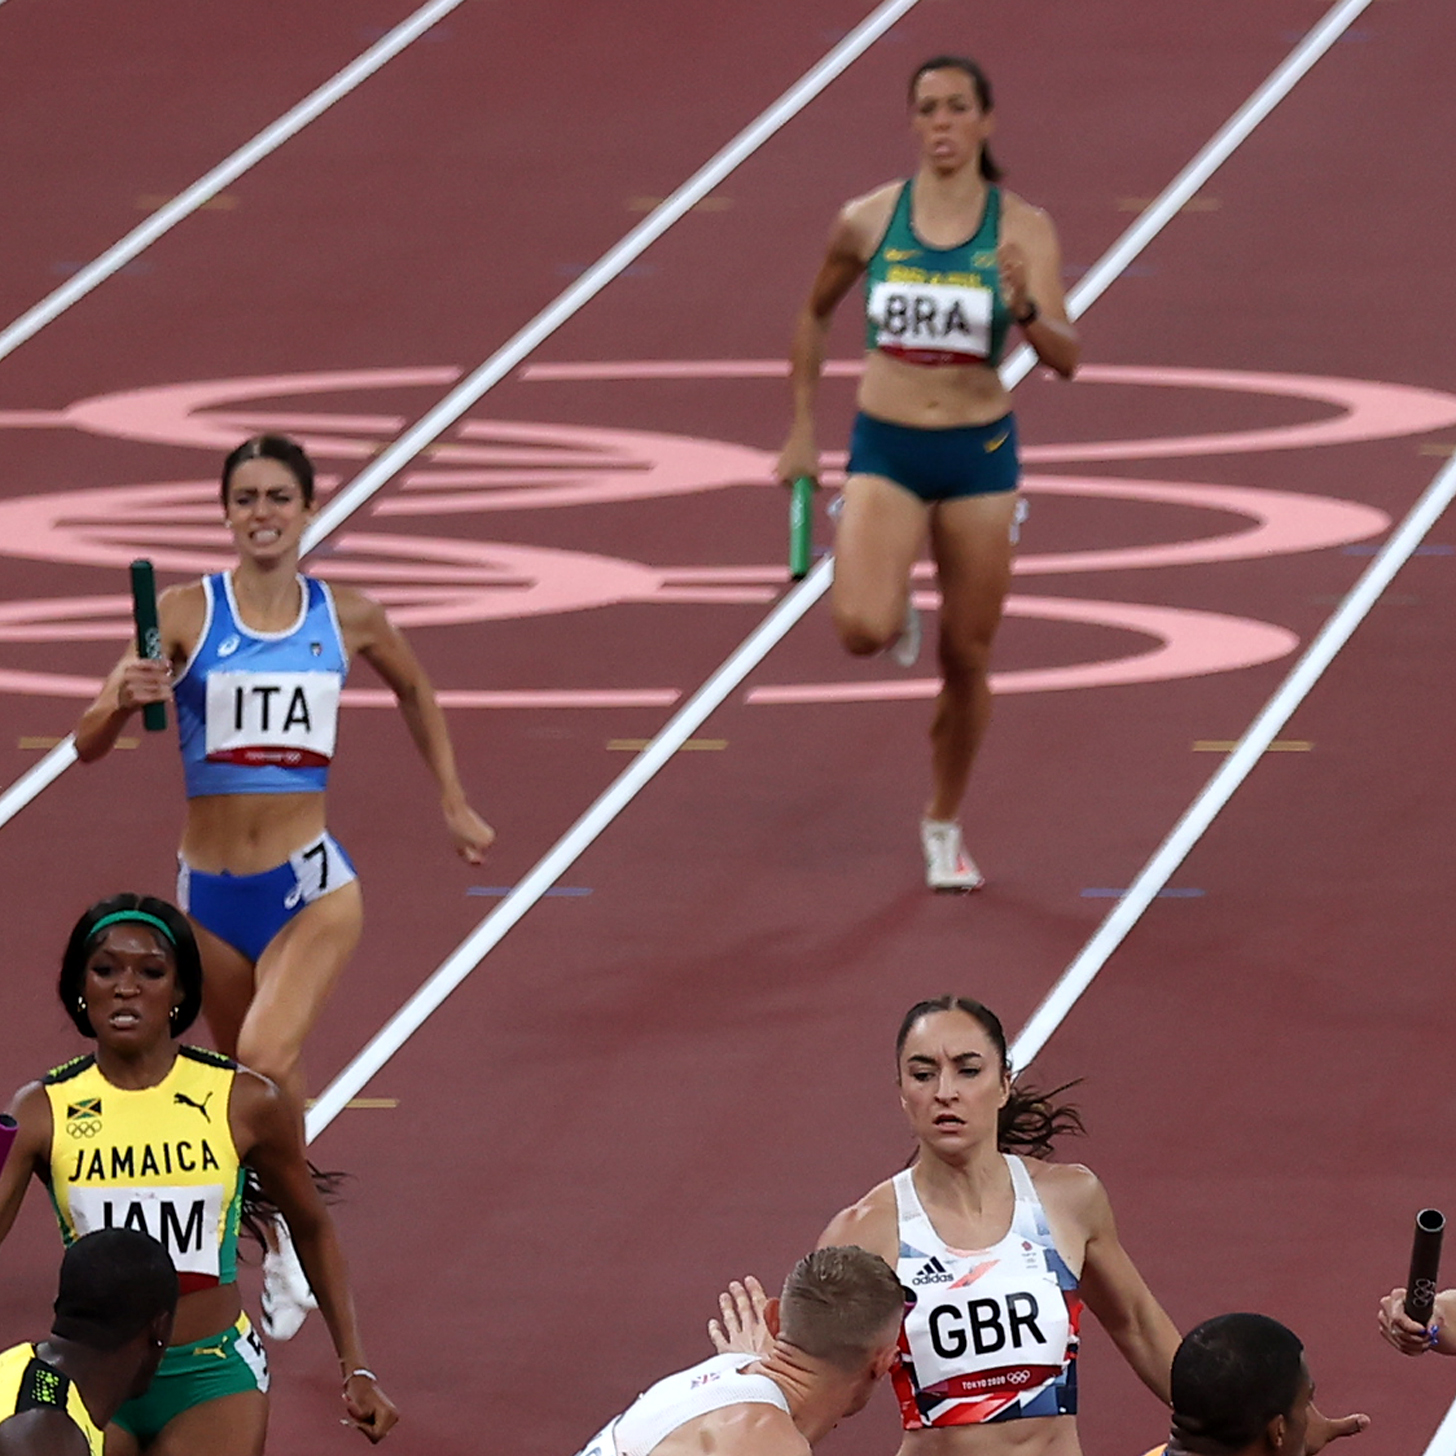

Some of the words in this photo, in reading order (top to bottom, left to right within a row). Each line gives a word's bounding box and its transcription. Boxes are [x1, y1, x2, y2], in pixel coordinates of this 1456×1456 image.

[885, 294, 971, 338] BRA
[234, 686, 311, 733] ITA
[302, 842, 329, 889] 7
[67, 1139, 220, 1182] JAMAICA
[911, 1272, 955, 1286] adidas
[928, 1292, 1047, 1359] GBR
[962, 1378, 988, 1390] TOKYO
